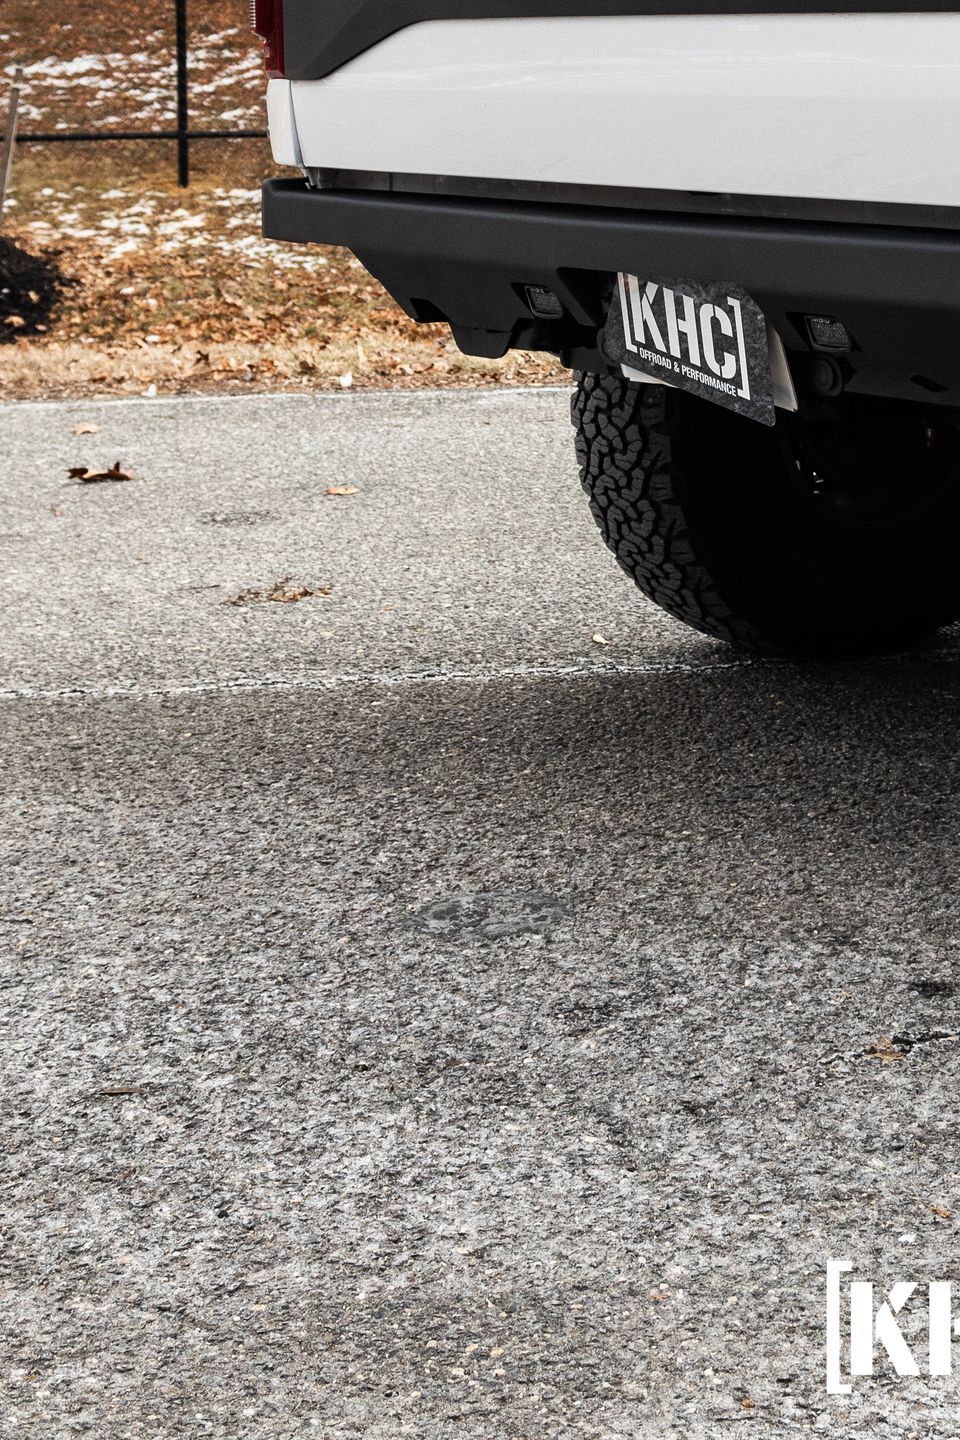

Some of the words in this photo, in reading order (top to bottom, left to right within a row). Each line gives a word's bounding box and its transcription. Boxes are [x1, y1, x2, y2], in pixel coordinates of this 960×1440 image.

[639, 347, 672, 372] OFFROAD
[673, 361, 680, 373] &
[681, 364, 737, 397] PERFORMANCE
